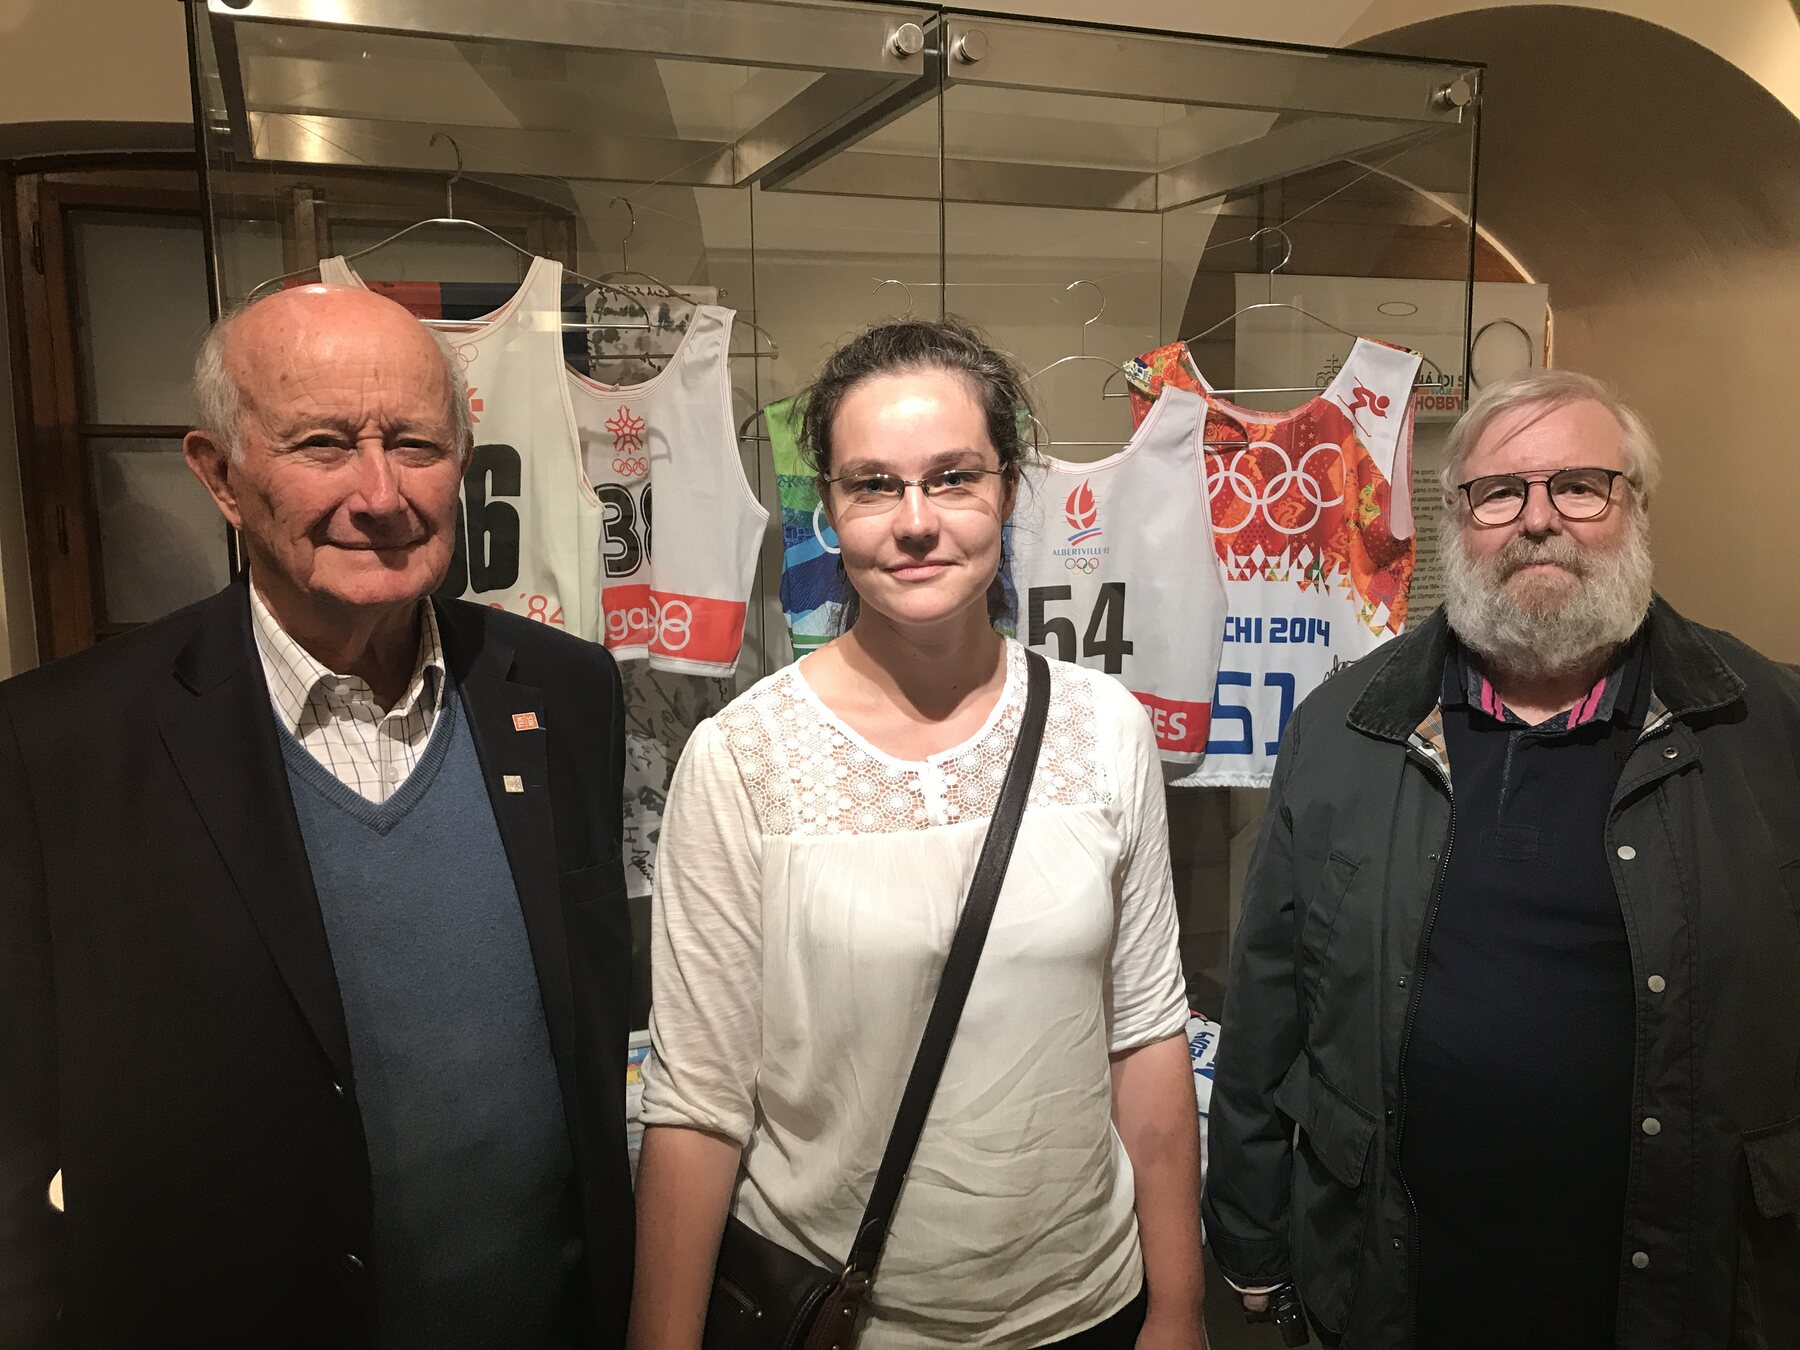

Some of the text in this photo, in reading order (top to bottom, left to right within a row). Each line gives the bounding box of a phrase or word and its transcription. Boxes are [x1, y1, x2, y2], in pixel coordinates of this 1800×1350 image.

[439, 444, 522, 598] 6
[1052, 547, 1103, 557] ALBERTVILLE
[1028, 581, 1134, 675] 54
[1223, 616, 1331, 648] CHI 2014
[1144, 703, 1188, 741] ES
